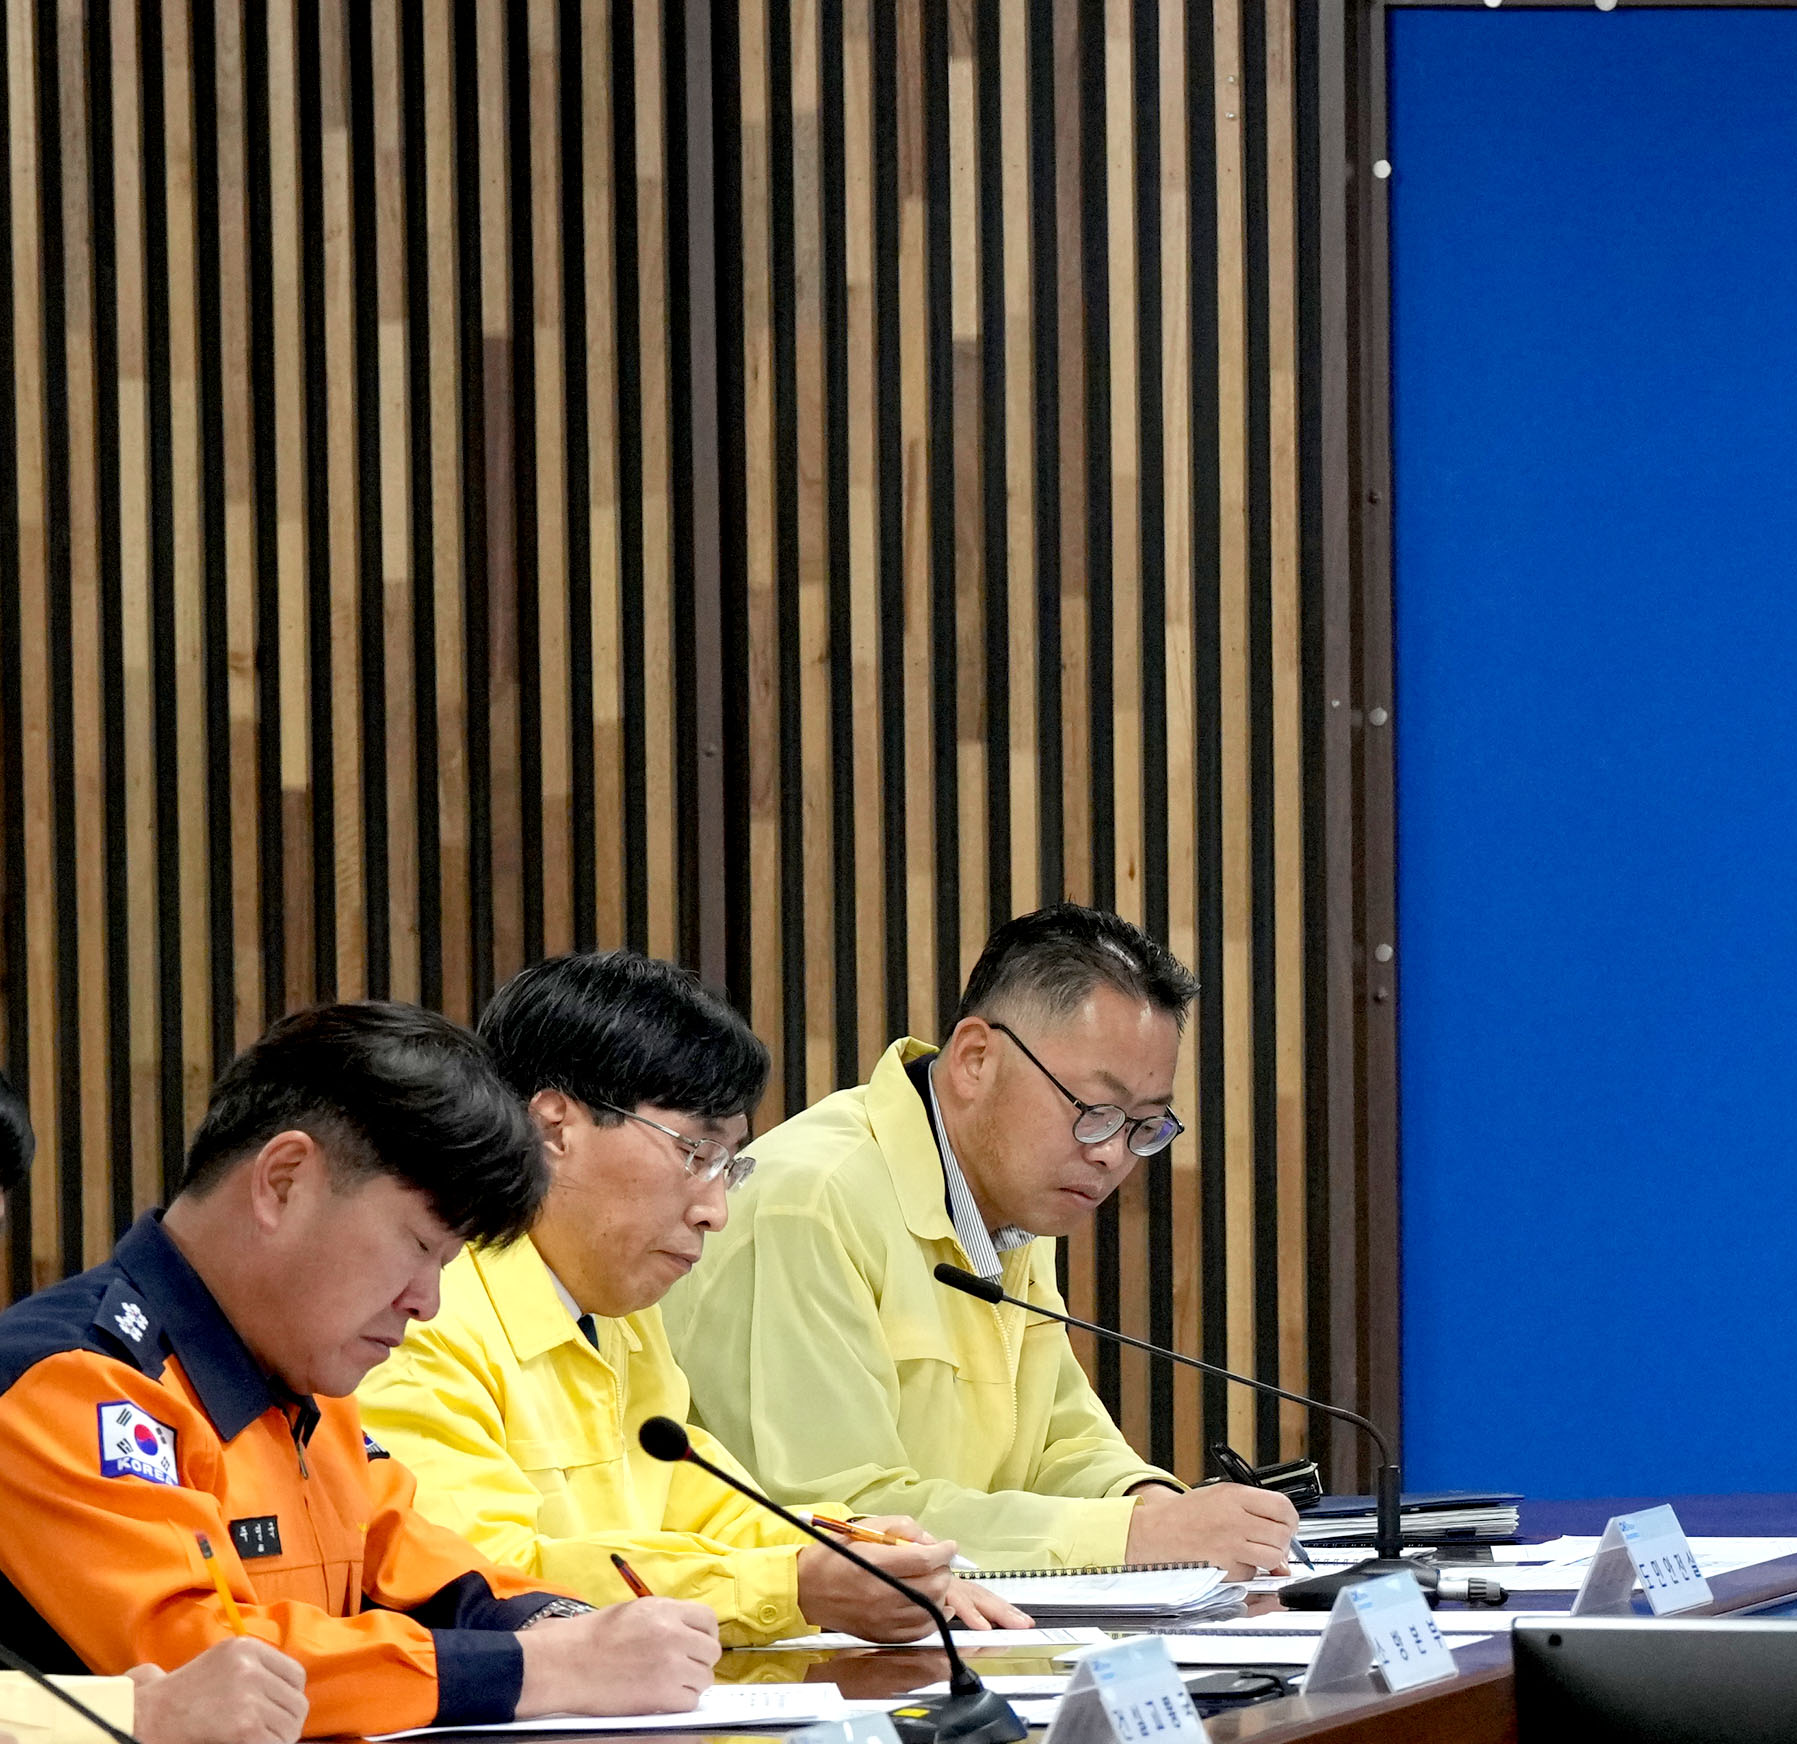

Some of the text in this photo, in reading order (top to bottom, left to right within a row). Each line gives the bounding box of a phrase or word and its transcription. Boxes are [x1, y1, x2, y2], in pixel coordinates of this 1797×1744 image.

[117, 1456, 176, 1486] KOREA
[1639, 1550, 1702, 1589] 도민안전실
[1374, 1618, 1444, 1665] 소방본부
